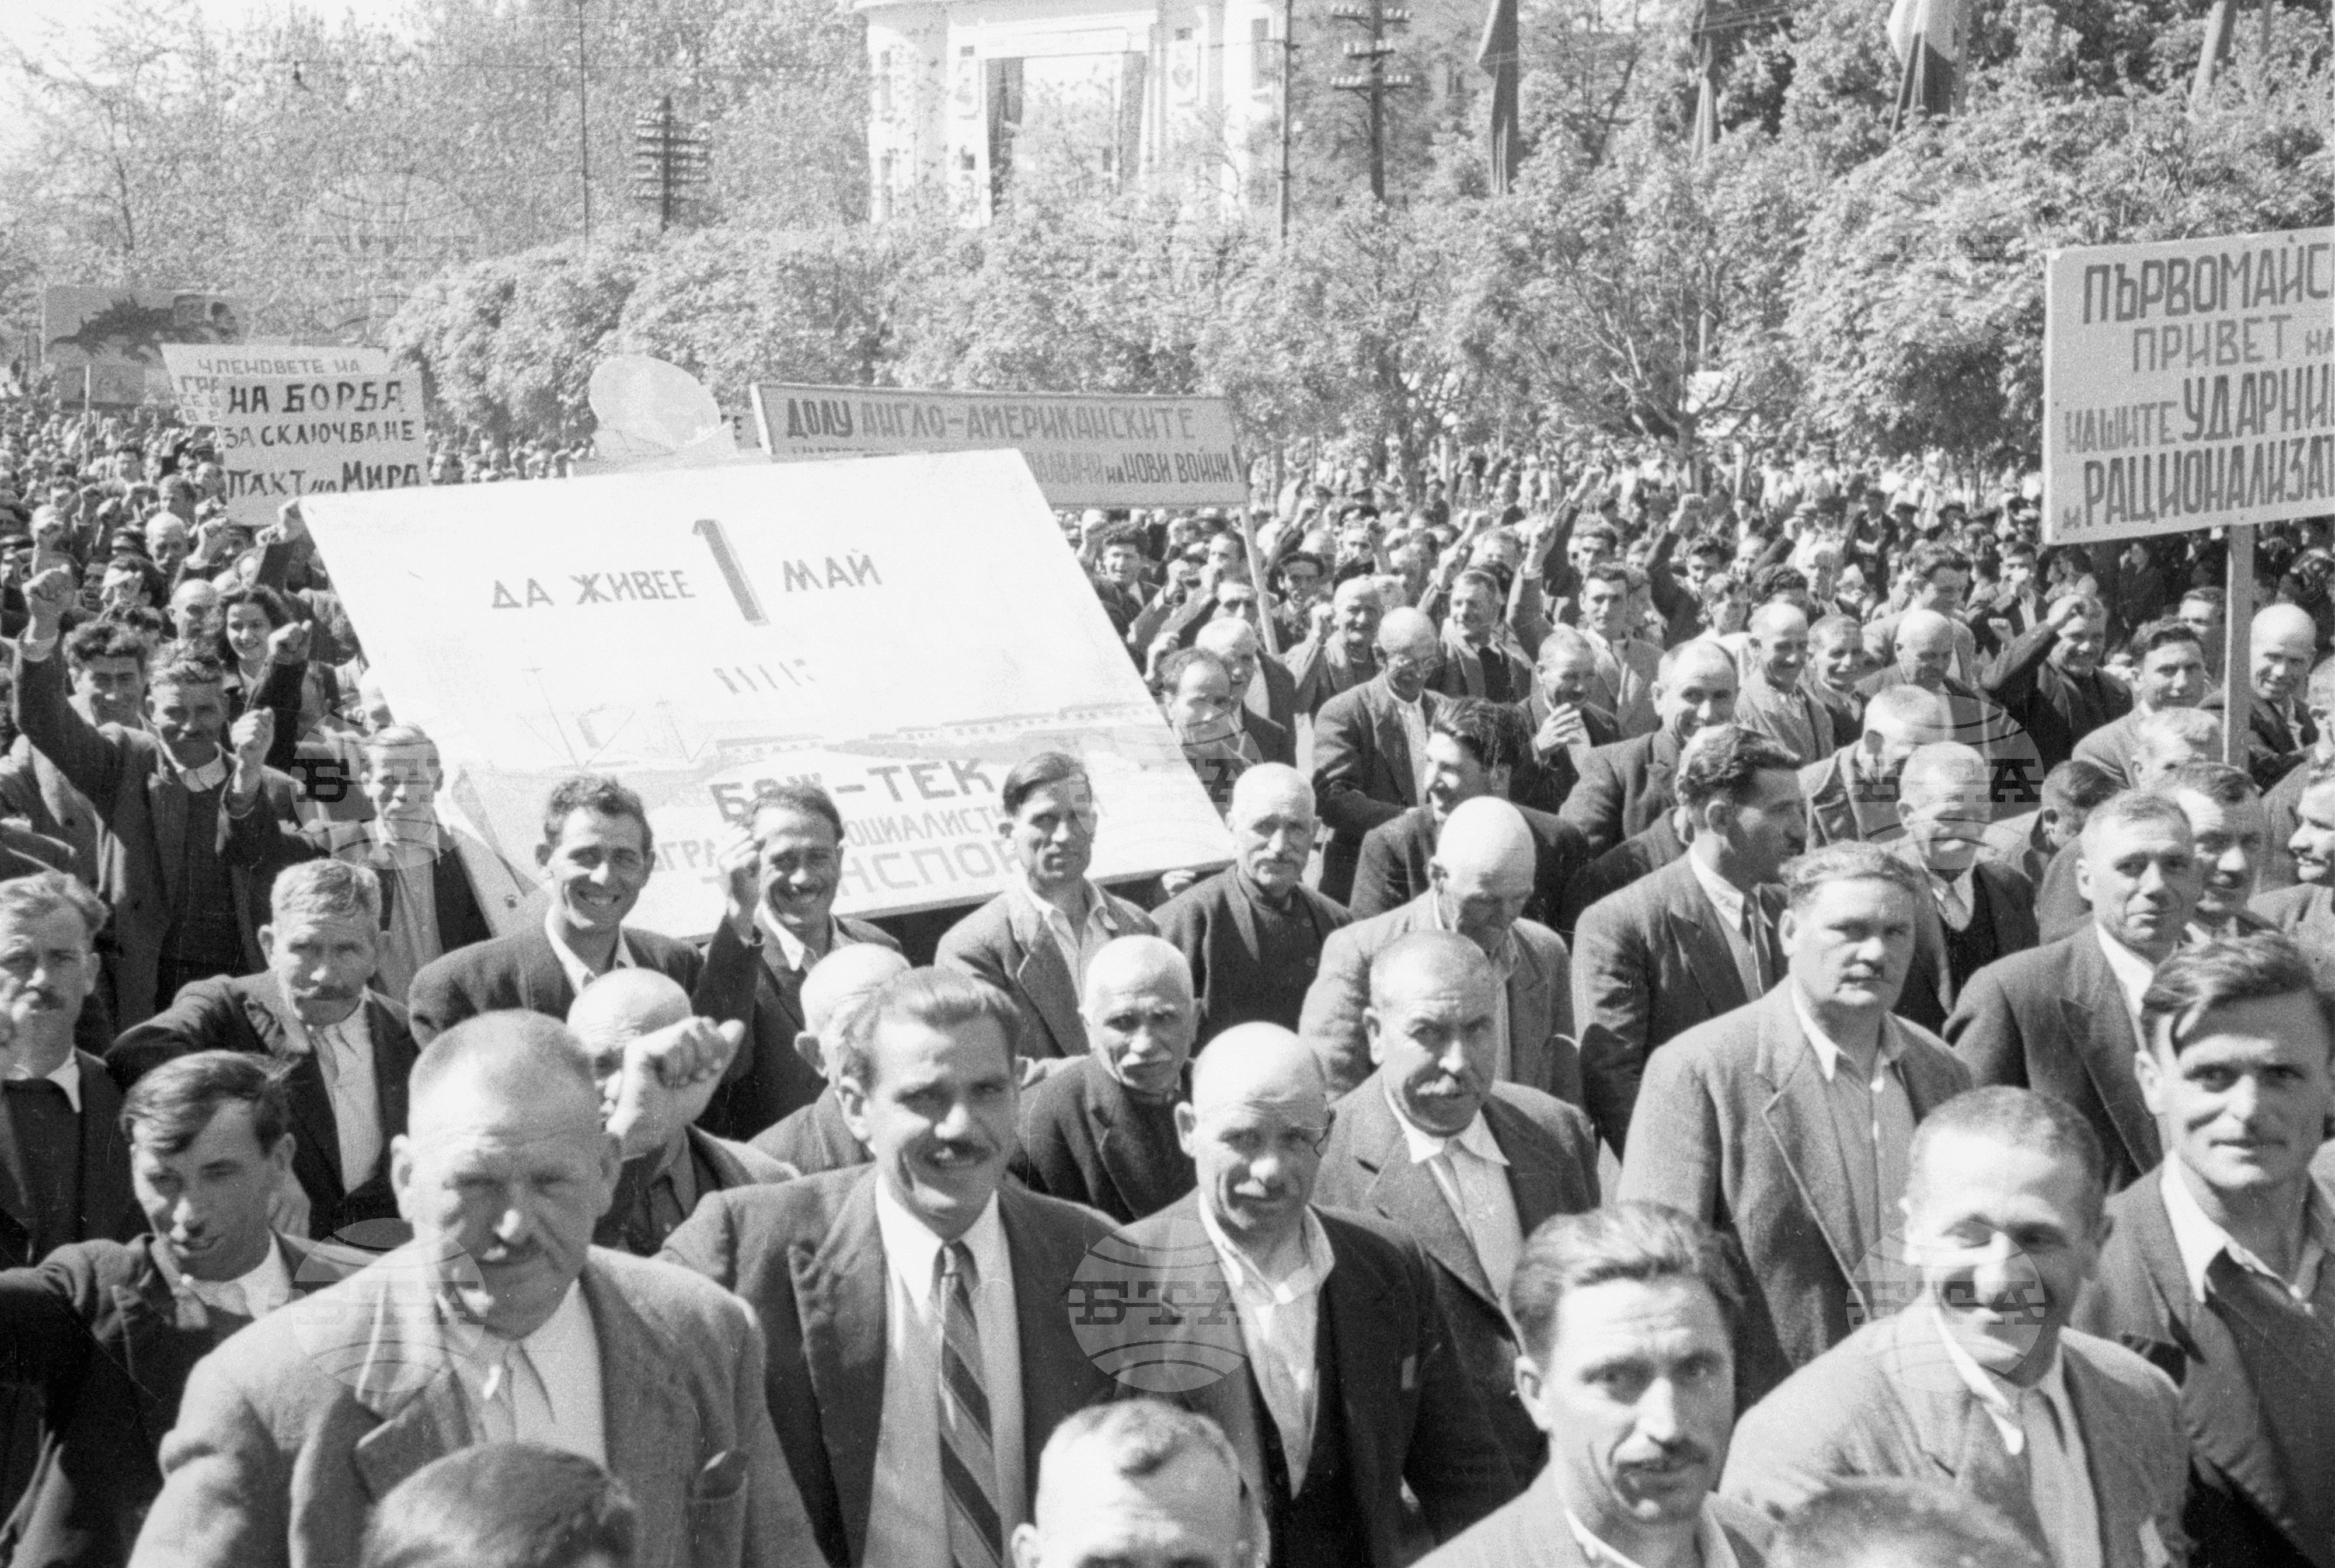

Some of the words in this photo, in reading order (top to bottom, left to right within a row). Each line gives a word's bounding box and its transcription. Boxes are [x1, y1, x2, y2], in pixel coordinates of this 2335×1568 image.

[2083, 235, 2334, 325] ПЪРВОМАЙС
[2132, 313, 2292, 372] ПРИВЕТ
[335, 358, 361, 374] НА
[228, 385, 270, 414] НА
[281, 380, 405, 413] БОРБА
[2065, 400, 2178, 454] НАШИТЕ
[2182, 363, 2334, 442] УДАРНИ
[224, 425, 256, 449] ЗА
[260, 420, 415, 447] СКЛЮЧВАНЕ
[787, 398, 853, 440] ДОЛУ
[860, 401, 1196, 440] АНГЛО-АМЕРИКАНСКИТЕ
[227, 468, 306, 499] ПАКТ
[1123, 452, 1172, 483] НОВИ
[1175, 443, 1243, 485] ВОЙНИ!
[492, 578, 555, 609] ДА
[569, 569, 697, 605] ЖИВЕЕ
[692, 519, 771, 626] 1
[782, 548, 883, 593] МАЙ
[845, 804, 1009, 848] ОЦИАЛИСТ
